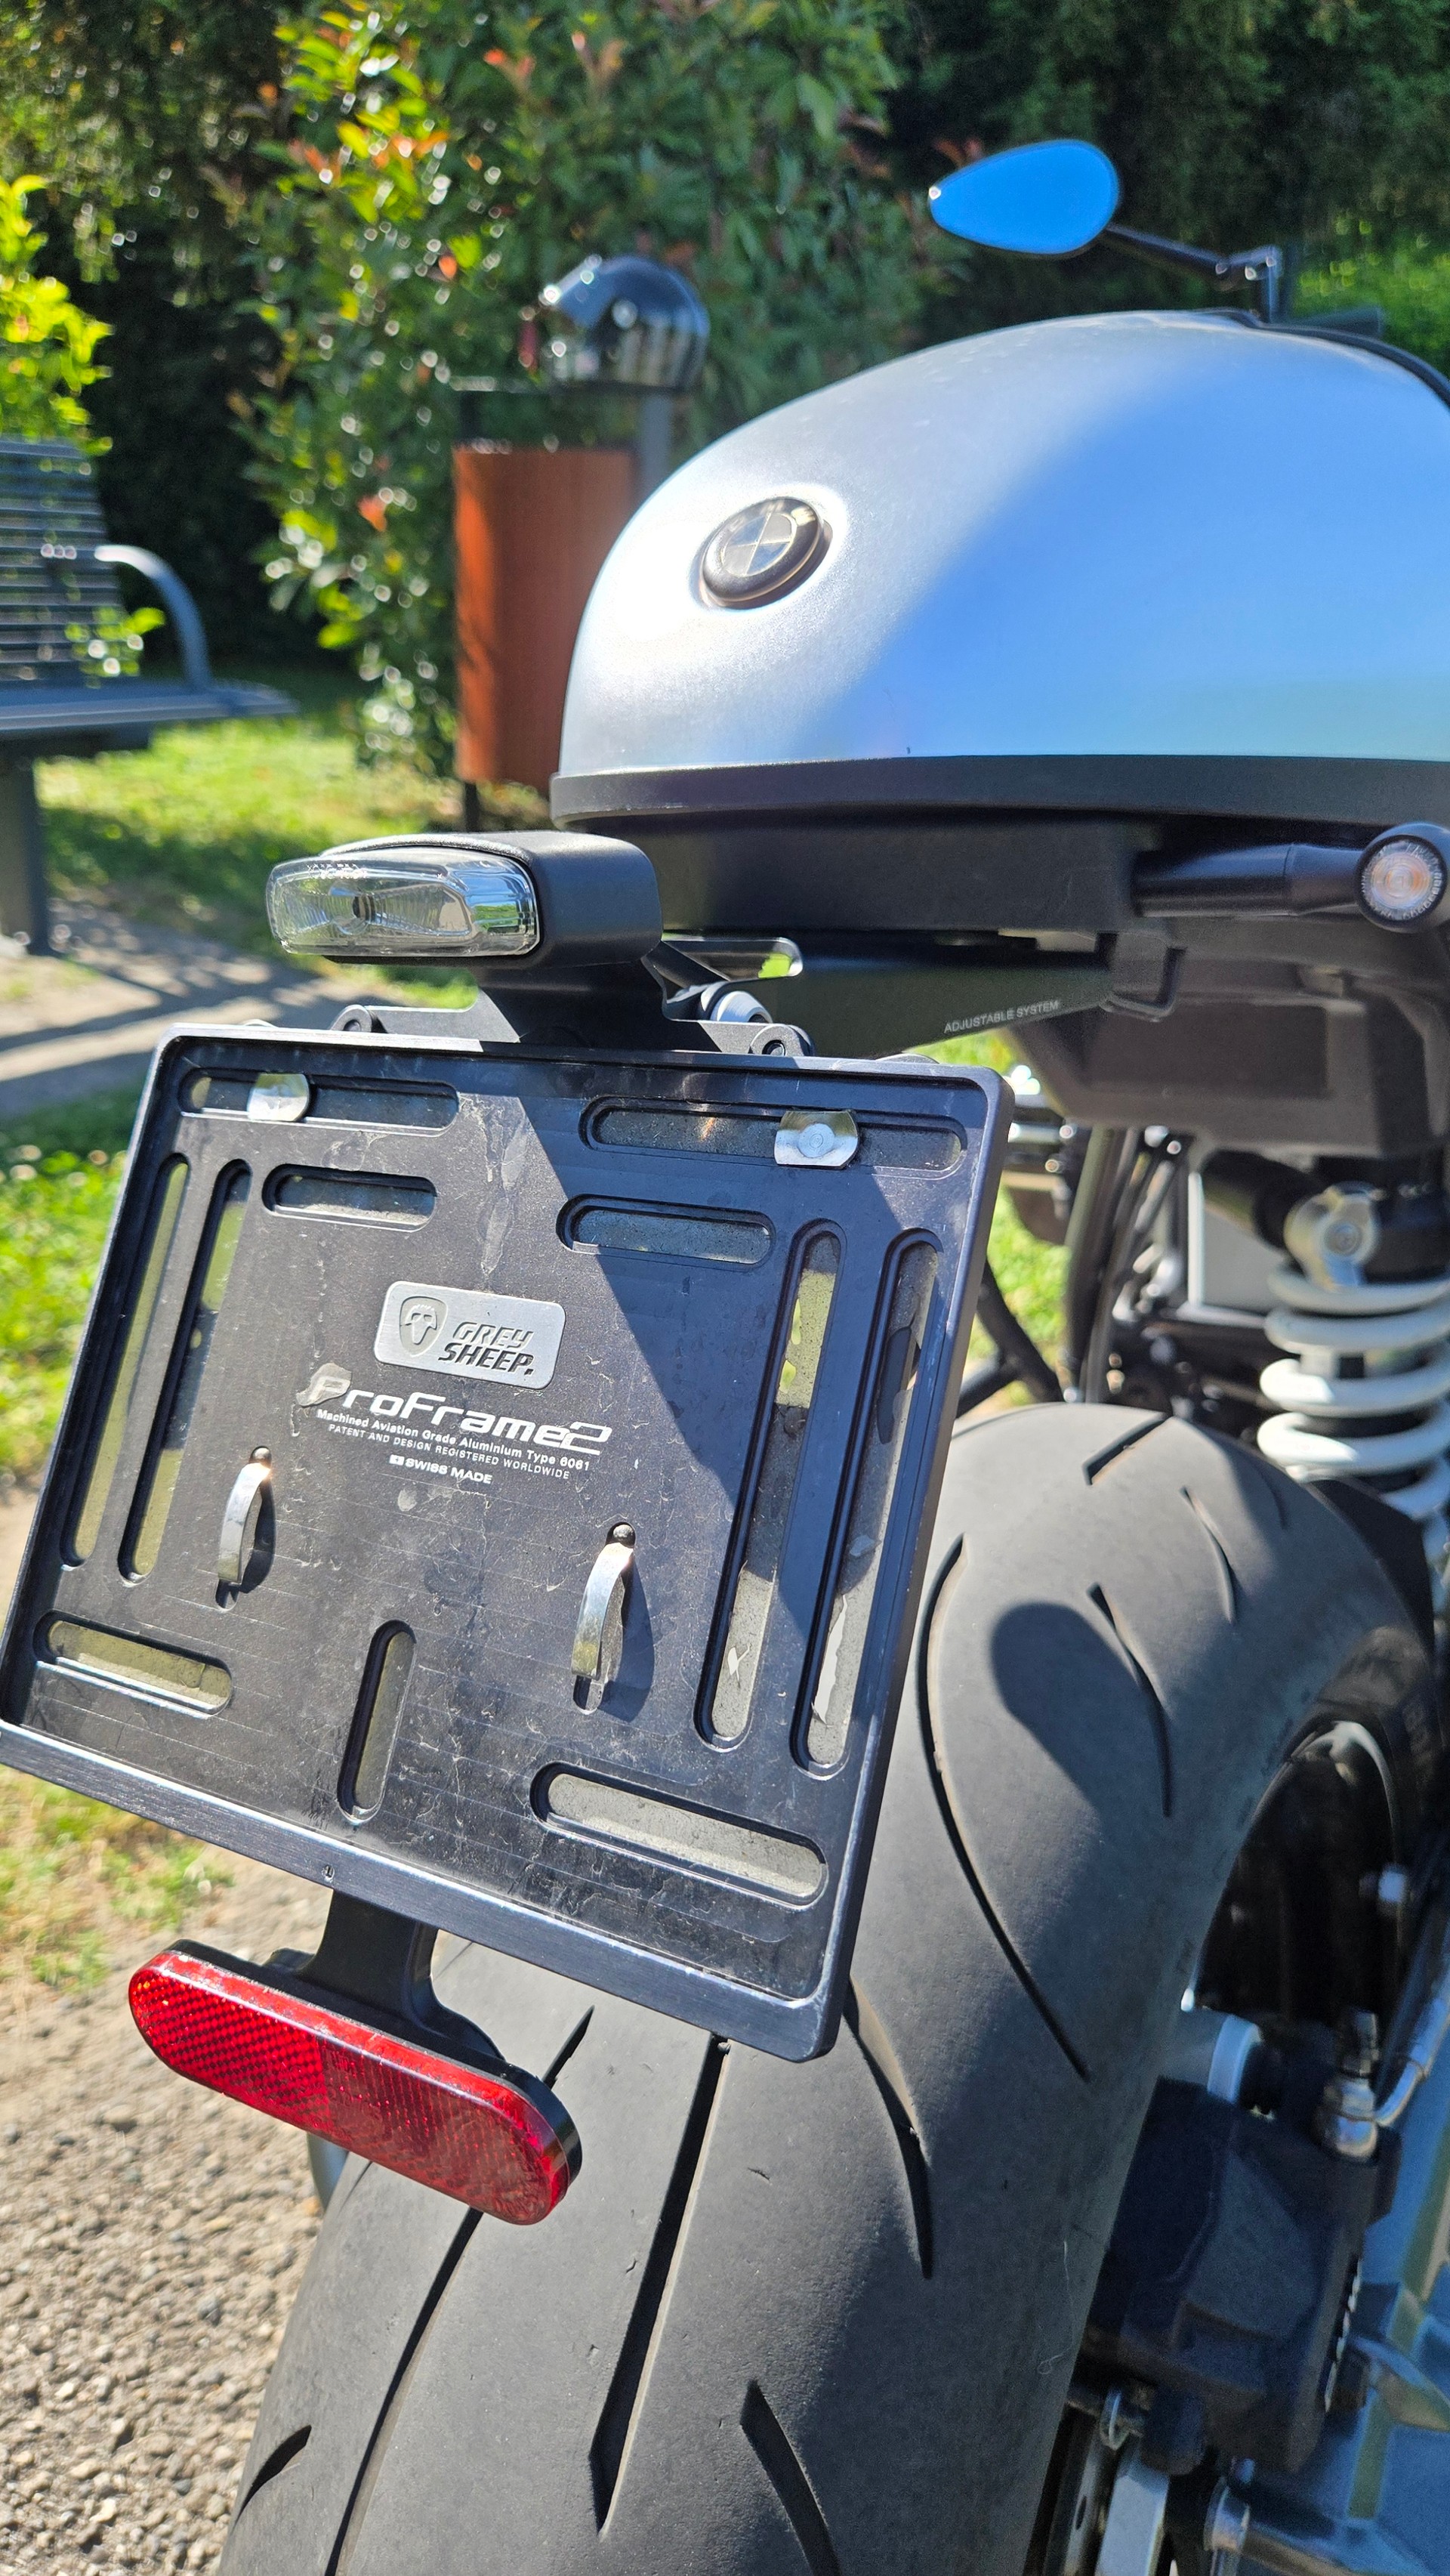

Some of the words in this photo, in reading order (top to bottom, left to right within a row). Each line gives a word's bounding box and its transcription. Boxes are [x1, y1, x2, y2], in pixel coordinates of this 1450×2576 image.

[944, 1008, 1013, 1033] ADJUSTABLE
[1017, 999, 1060, 1018] SYSTEM
[452, 1321, 534, 1350] GREY
[316, 1409, 369, 1428] Machined
[372, 1420, 418, 1438] Aviation
[422, 1429, 456, 1444] Grade
[459, 1437, 522, 1458] Aluminium
[527, 1449, 556, 1465] Type
[560, 1456, 590, 1471] 6061
[329, 1423, 366, 1438] PATENT
[368, 1432, 390, 1443] AND
[393, 1437, 431, 1451] DESIGN
[435, 1445, 499, 1465] REGISTERED
[503, 1458, 570, 1479] WORLDWIDE
[404, 1458, 448, 1474] SWISS
[450, 1467, 492, 1484] MADE
